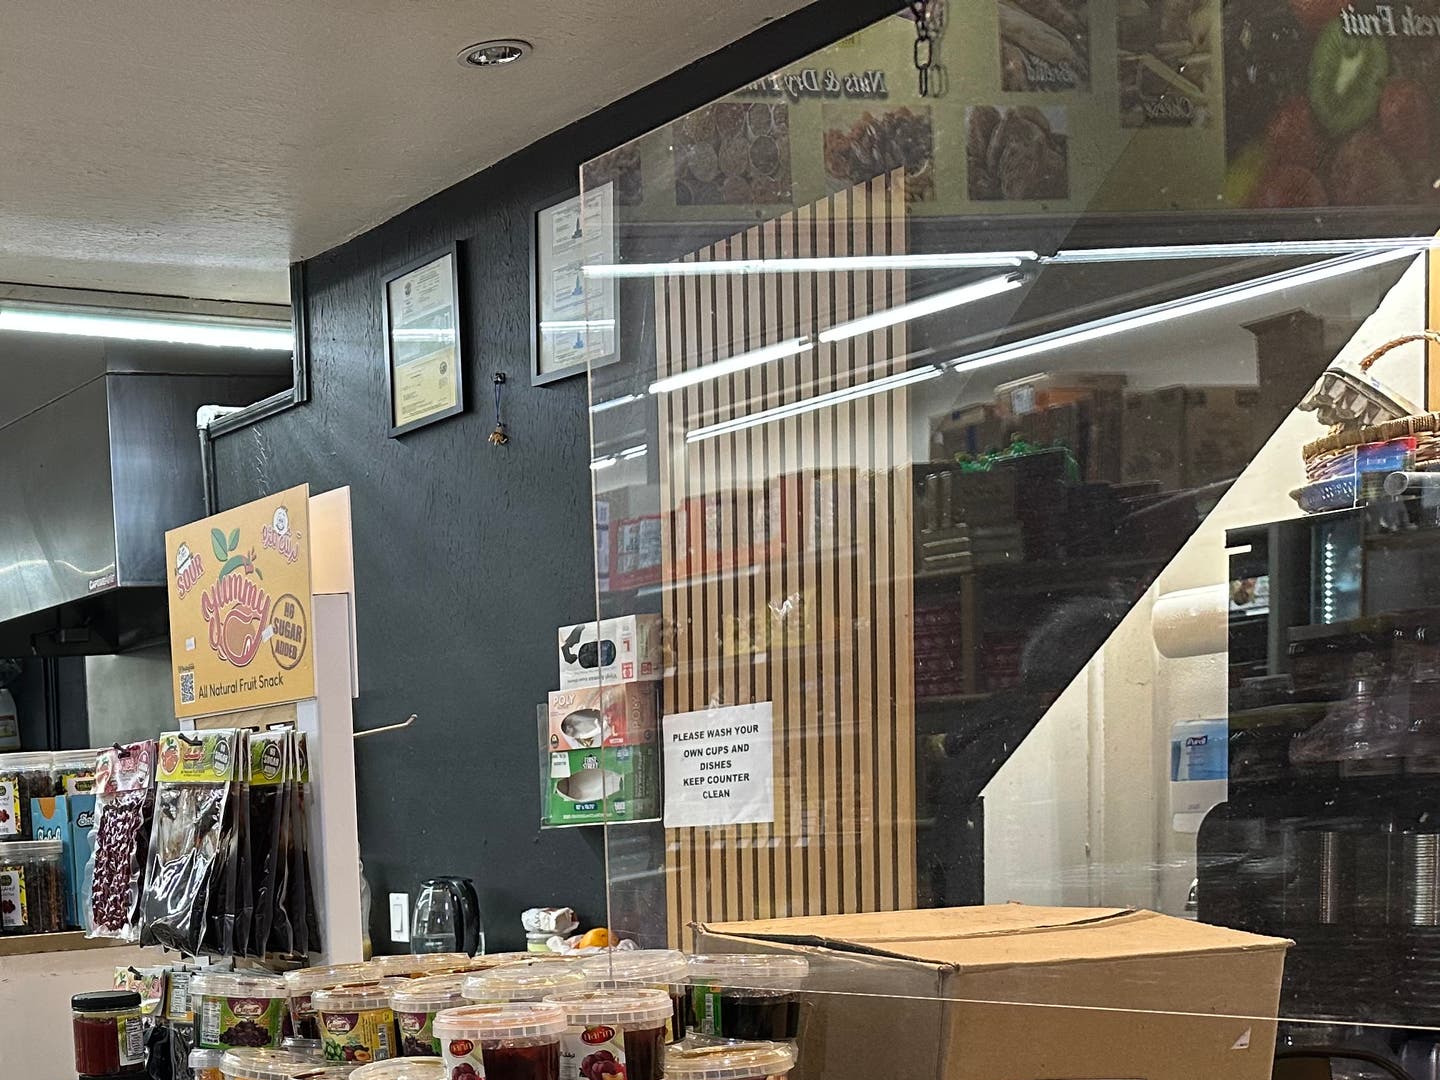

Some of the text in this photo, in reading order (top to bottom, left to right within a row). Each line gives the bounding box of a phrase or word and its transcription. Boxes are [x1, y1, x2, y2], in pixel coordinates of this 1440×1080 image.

[177, 553, 205, 600] SOUR
[283, 601, 296, 619] NO
[272, 617, 302, 643] SUGAR
[274, 639, 299, 660] ADDED
[198, 671, 284, 699] All Natural Fruit Snack
[553, 693, 575, 707] POLY
[672, 724, 759, 742] PLEASE WASH YOUR
[683, 743, 750, 758] OWN CUPS AND
[699, 760, 732, 771] DISHES
[683, 772, 750, 787] KEEP COUNTER
[702, 788, 730, 799] CLEAN
[584, 1027, 614, 1041] narin
